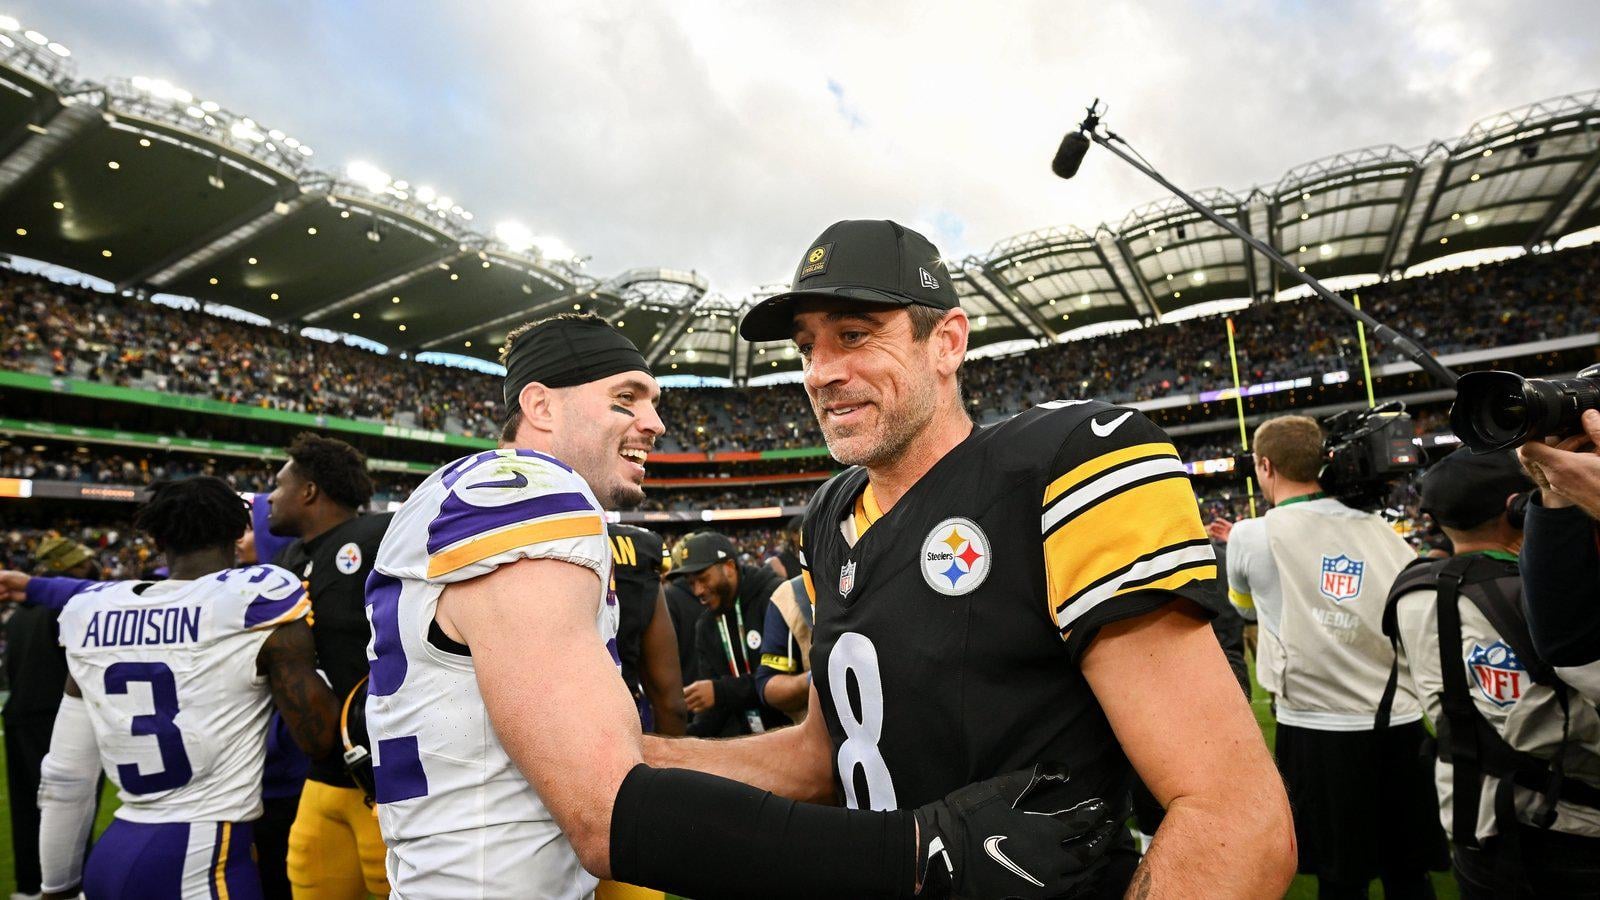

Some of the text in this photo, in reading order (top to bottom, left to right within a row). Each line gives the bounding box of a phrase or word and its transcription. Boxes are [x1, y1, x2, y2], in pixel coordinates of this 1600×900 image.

[927, 551, 953, 561] Steelers
[1324, 573, 1356, 596] NFL
[82, 606, 201, 648] ADDISON
[1312, 607, 1360, 630] MEDIA
[104, 661, 192, 795] 3
[828, 632, 897, 811] 8
